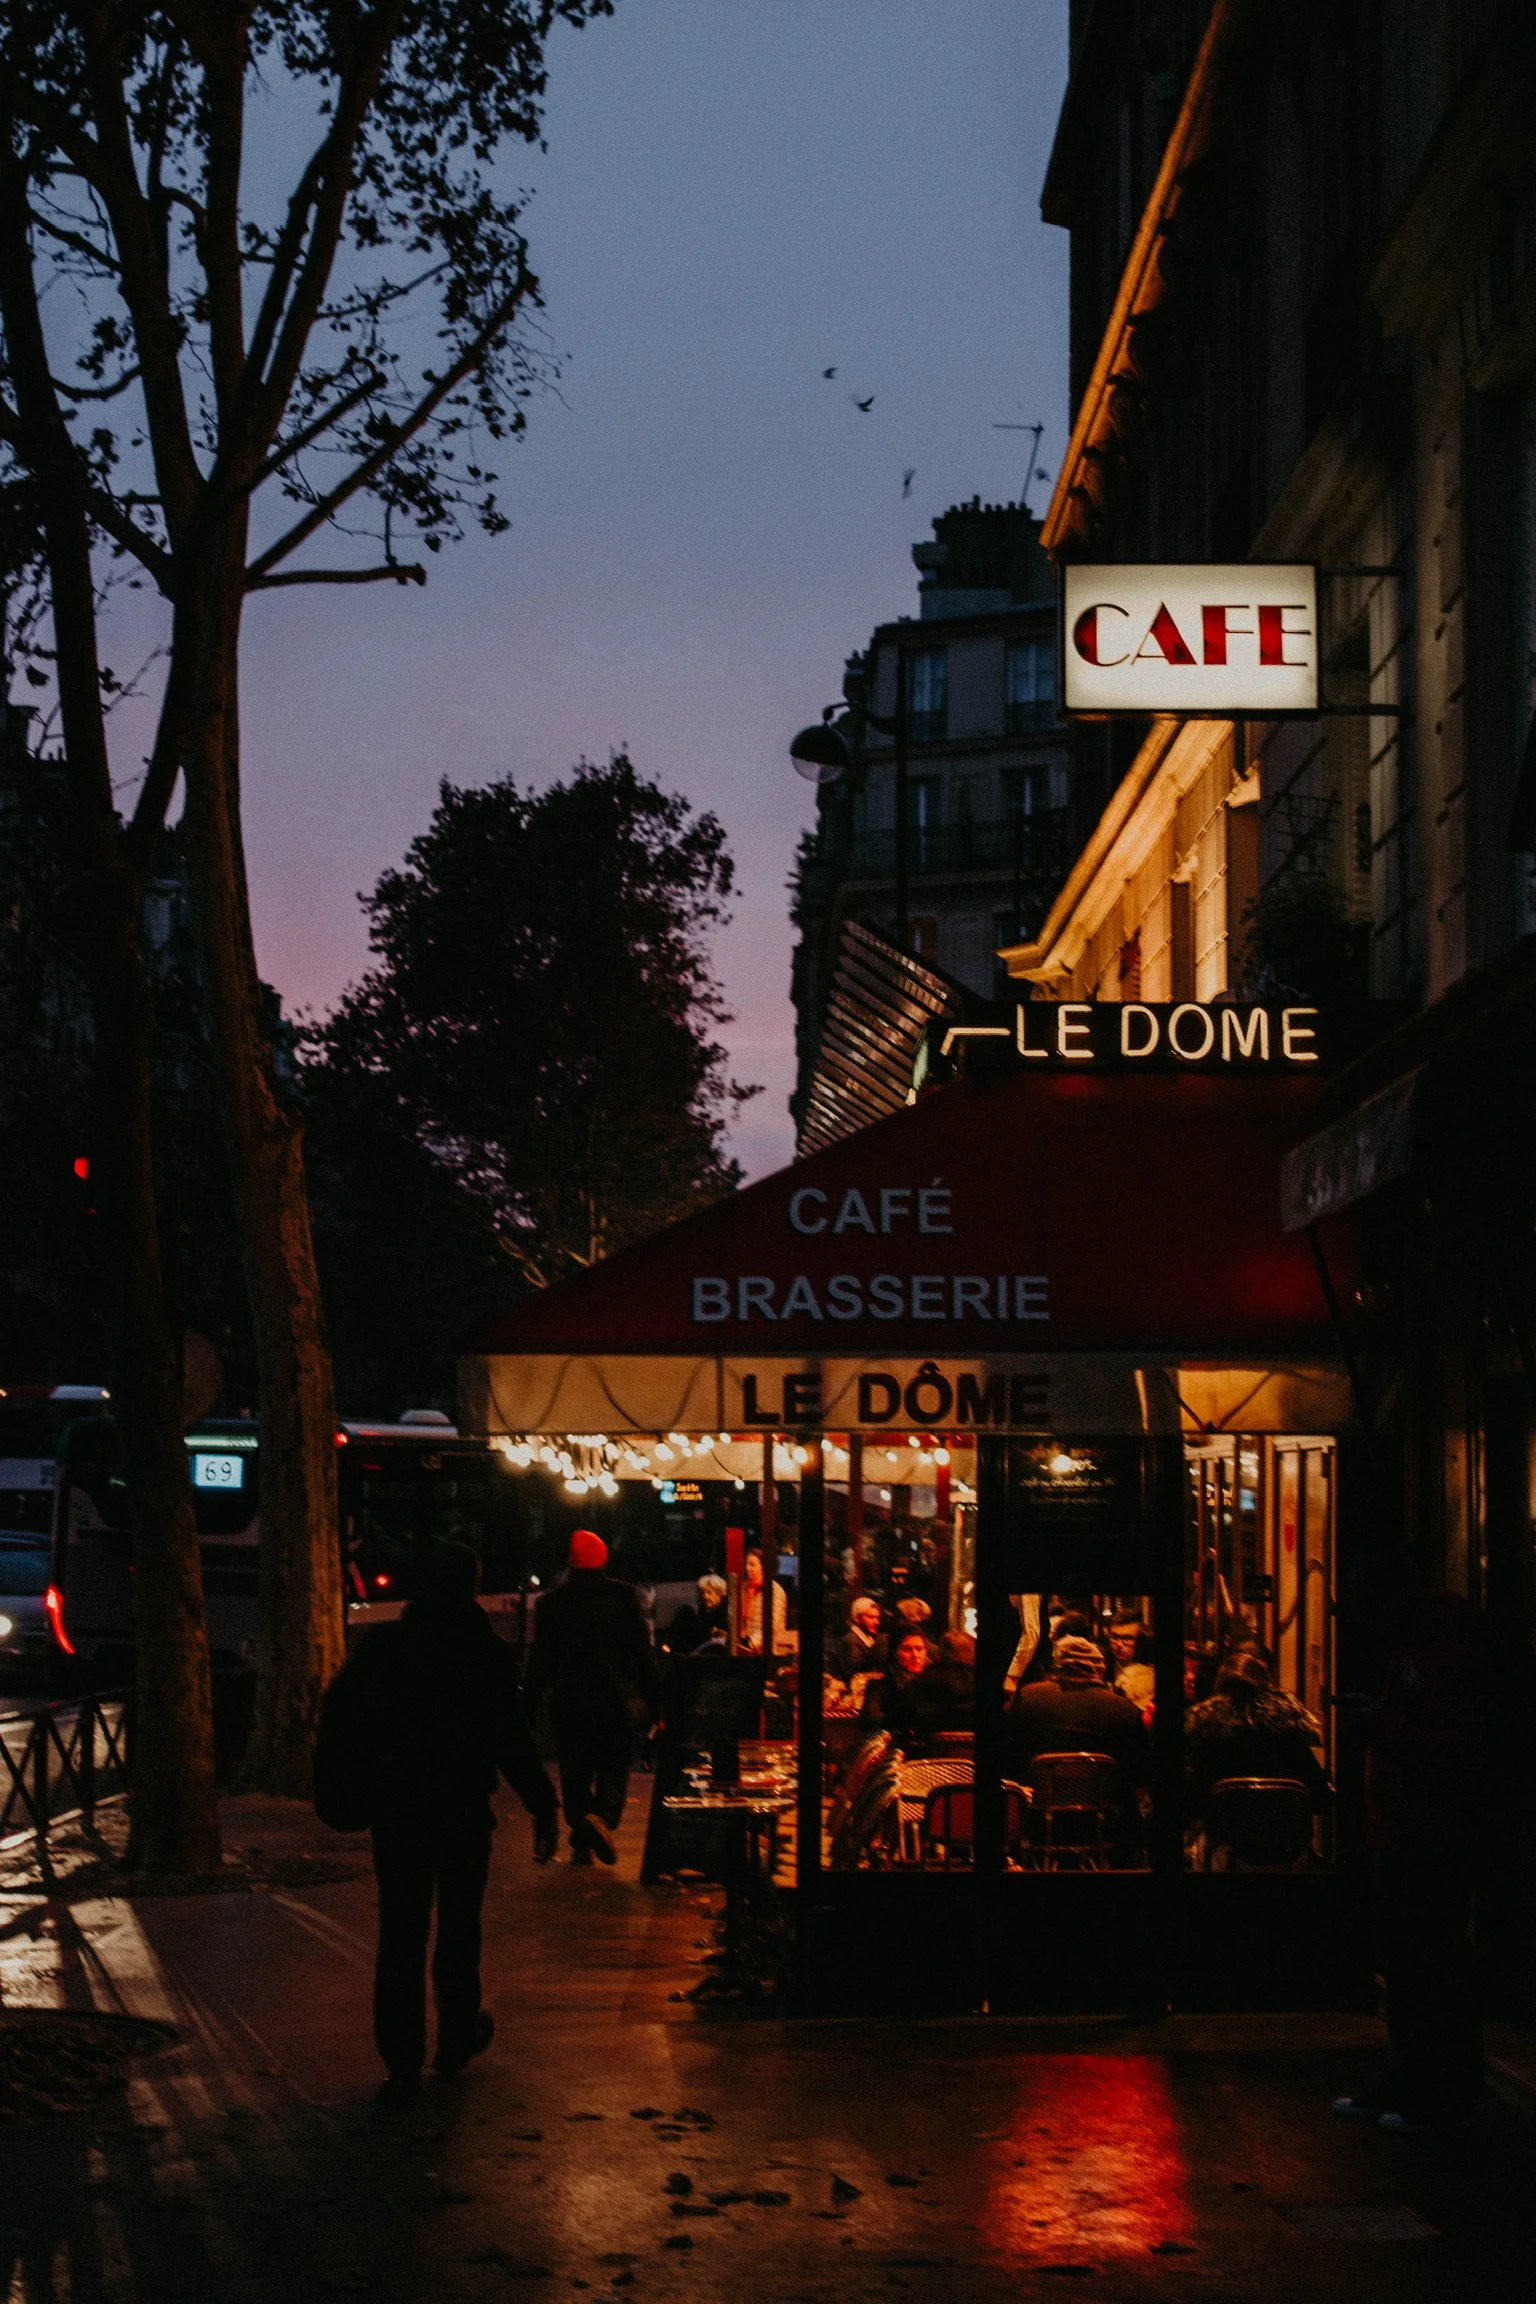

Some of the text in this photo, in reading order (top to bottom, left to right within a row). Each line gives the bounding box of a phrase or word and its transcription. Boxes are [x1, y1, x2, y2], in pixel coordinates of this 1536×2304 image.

[1073, 601, 1312, 667] CAFE
[1016, 1003, 1319, 1061] LE DOME
[788, 1177, 954, 1236] CAFÉ
[691, 1275, 1051, 1323] BRASSERIE
[742, 1362, 1051, 1425] LE DÔME
[206, 1461, 232, 1482] 69
